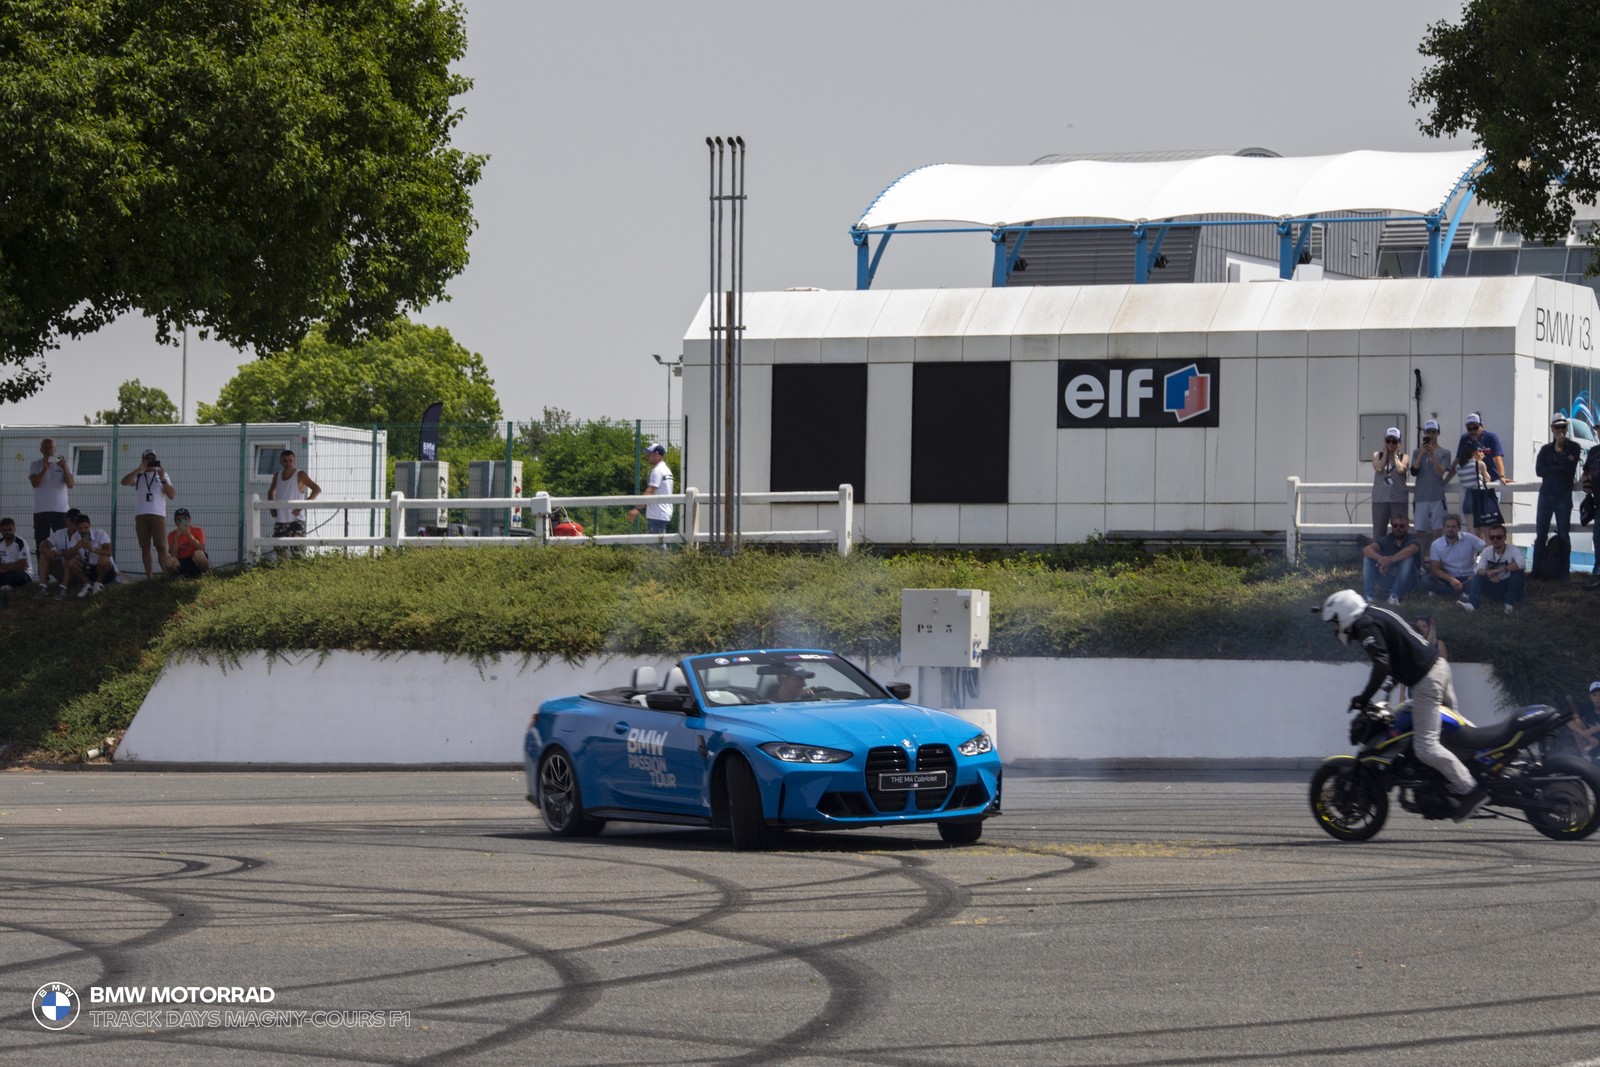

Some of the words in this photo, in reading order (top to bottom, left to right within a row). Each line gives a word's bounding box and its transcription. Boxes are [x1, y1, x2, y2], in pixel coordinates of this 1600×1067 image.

[1536, 307, 1574, 347] BMW
[1064, 368, 1153, 419] elf
[627, 728, 668, 756] BMW
[628, 754, 667, 772] PASSION
[649, 771, 676, 788] TOUR
